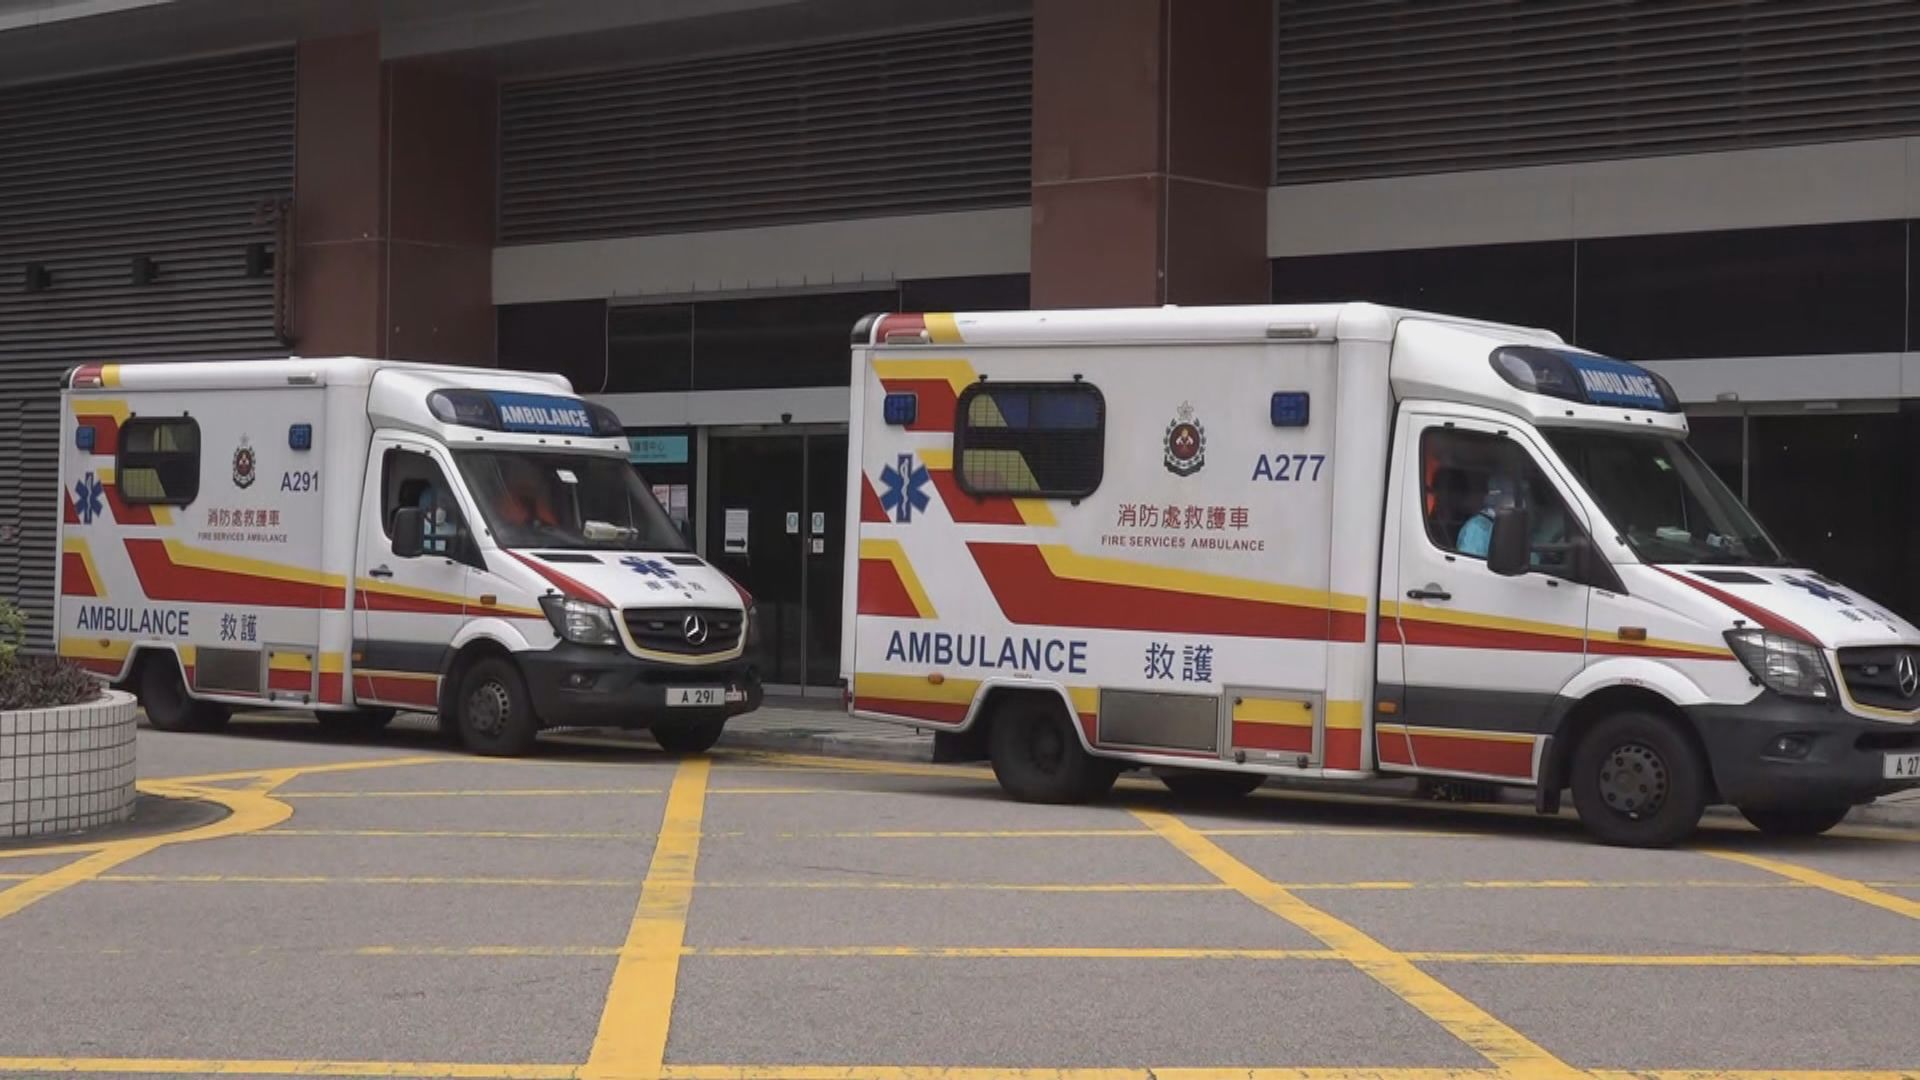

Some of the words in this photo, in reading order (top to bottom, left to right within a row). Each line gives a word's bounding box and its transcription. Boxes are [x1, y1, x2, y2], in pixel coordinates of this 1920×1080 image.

[1579, 368, 1662, 399] AMBULANCE
[501, 406, 591, 428] AMBULANCE
[1252, 454, 1326, 481] A277
[280, 471, 319, 492] A291
[1117, 503, 1249, 531] 消防處救護車
[198, 532, 211, 541] FIRE
[213, 532, 244, 541] SERVICES
[247, 533, 288, 543] AMBULANCE
[1101, 535, 1125, 546] FIRE
[1129, 536, 1186, 549] SERVICES
[1191, 538, 1265, 551] AMBULANCE
[77, 605, 190, 636] AMBULANCE
[220, 612, 257, 643] 救護
[885, 630, 1088, 674] AMBULANCE
[1144, 641, 1213, 683] 救護
[681, 690, 689, 704] A
[695, 690, 714, 704] 291
[1895, 757, 1903, 776] A
